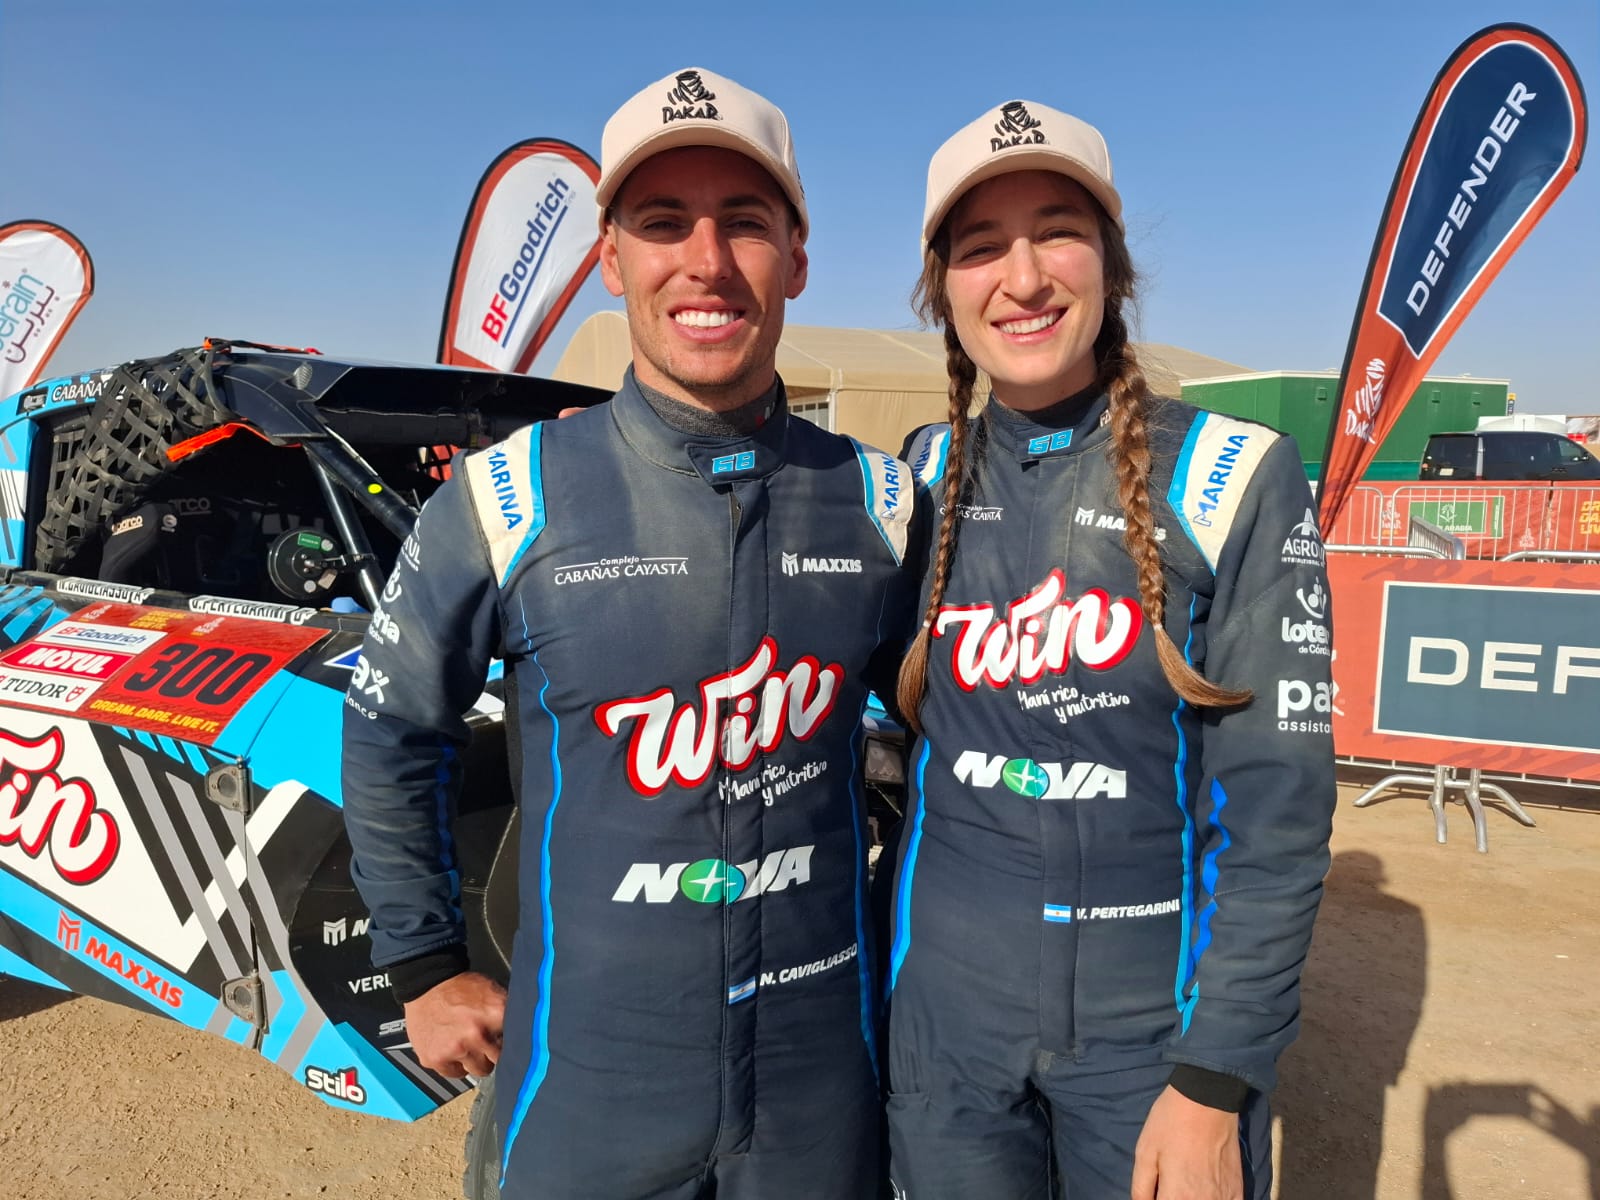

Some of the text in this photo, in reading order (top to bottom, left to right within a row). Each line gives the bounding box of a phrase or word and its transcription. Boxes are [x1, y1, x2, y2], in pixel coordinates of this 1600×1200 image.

[662, 102, 721, 124] DAKAR
[990, 129, 1045, 153] DAKAR
[1406, 82, 1537, 317] DEFENDER
[481, 177, 569, 342] BFGoodrich
[1193, 434, 1250, 527] MARINA
[554, 561, 689, 585] CABAÑAS CAYASTÁ
[802, 557, 863, 573] MAXXIS
[56, 626, 147, 645] BFGoodrich
[932, 567, 1143, 693] Win
[19, 647, 114, 674] MOTUL
[123, 642, 274, 706] 300
[1406, 635, 1600, 695] DEF
[2, 678, 68, 699] TUDOR
[1051, 684, 1079, 704] rico
[594, 635, 845, 797] Win
[1054, 691, 1131, 724] y nutritivo
[761, 760, 828, 806] y nutritivo
[1089, 898, 1180, 919] PERTEGARINI
[84, 936, 184, 1008] MAXXIS
[759, 942, 858, 986] N. CAVIGLIASSO
[305, 1067, 365, 1103] Stilo
